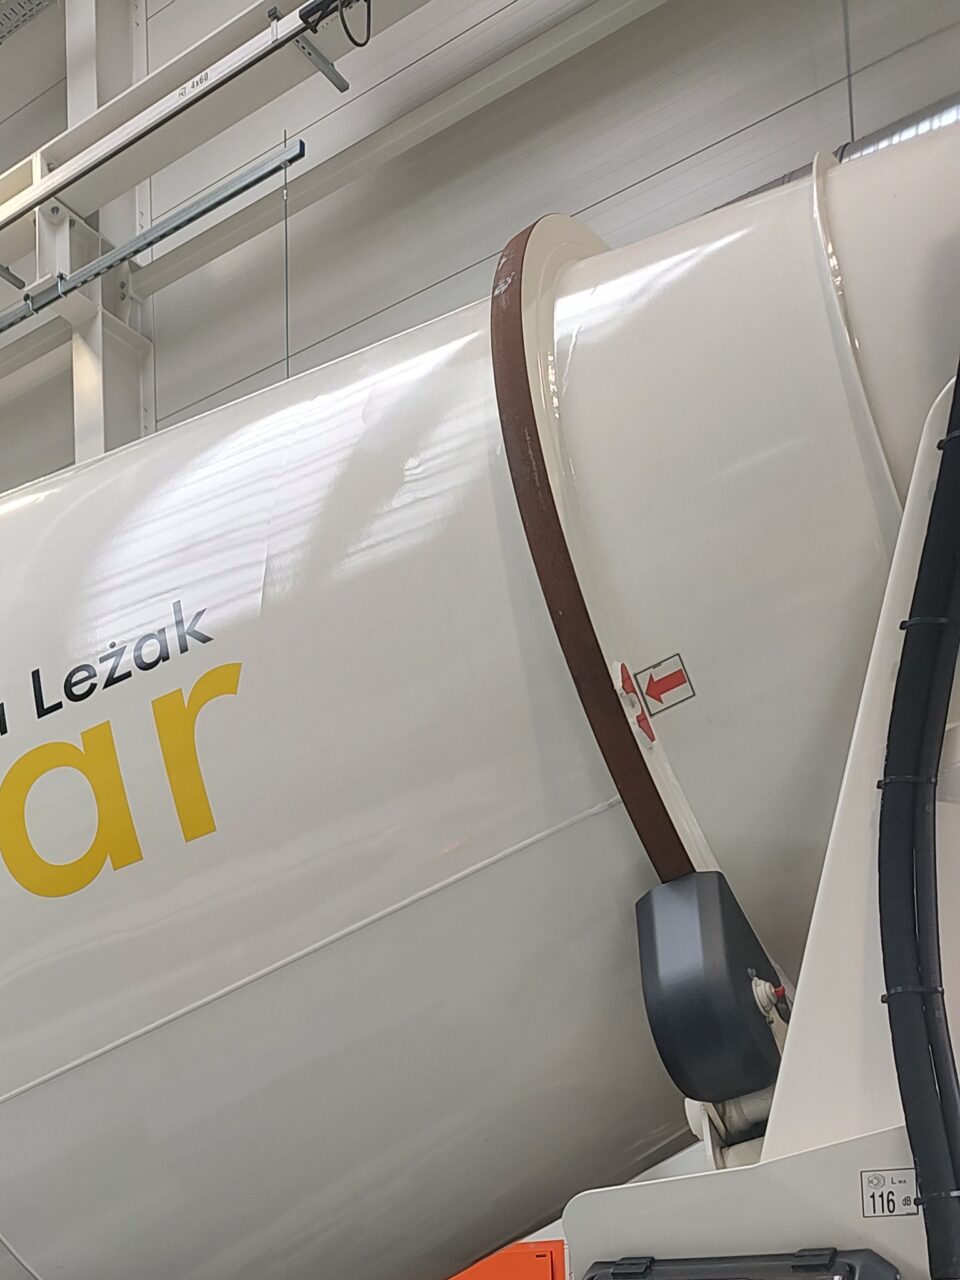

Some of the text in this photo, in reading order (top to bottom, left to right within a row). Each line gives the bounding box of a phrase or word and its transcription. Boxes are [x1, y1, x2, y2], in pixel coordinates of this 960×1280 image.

[30, 599, 215, 720] Leżak
[869, 1190, 912, 1215] 116 dB
